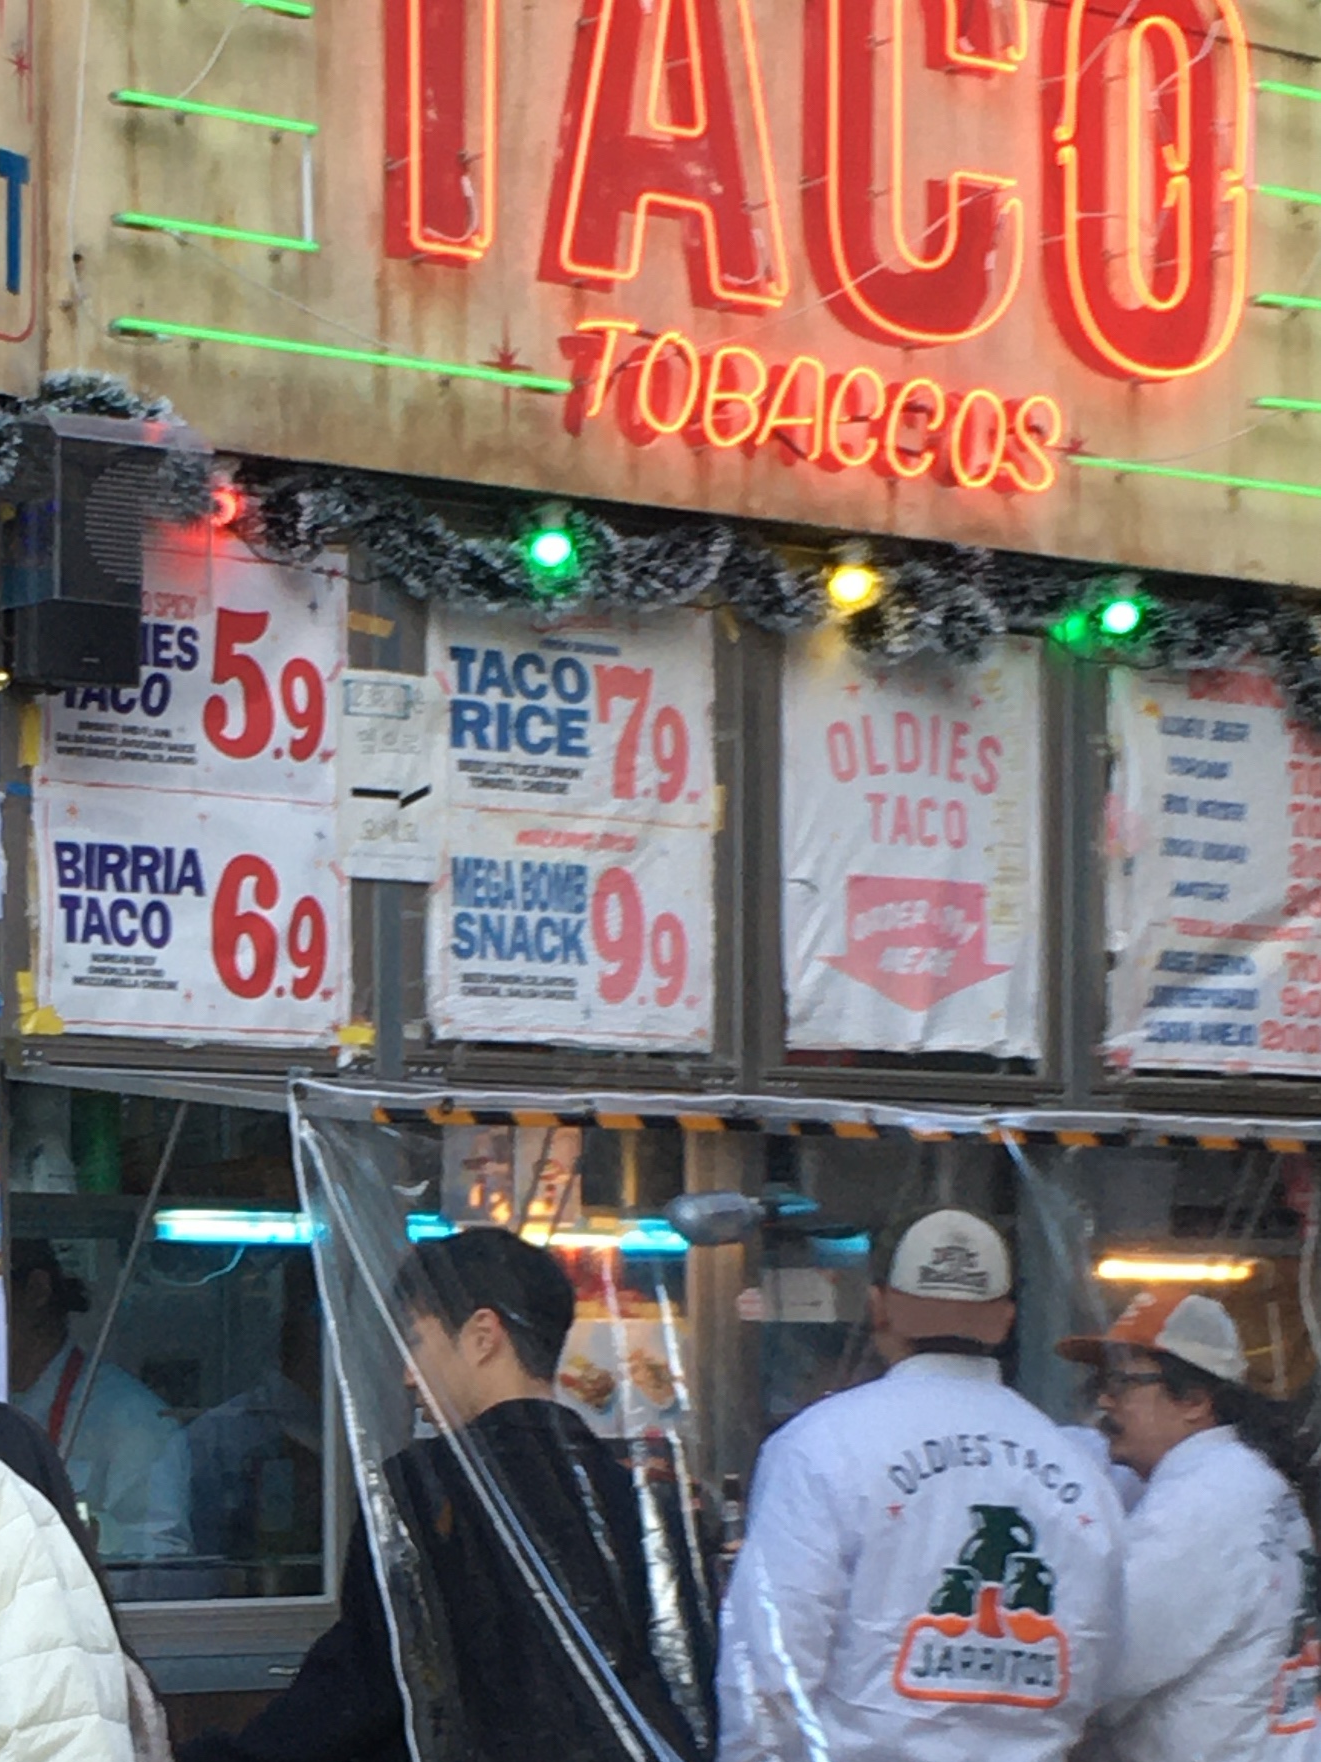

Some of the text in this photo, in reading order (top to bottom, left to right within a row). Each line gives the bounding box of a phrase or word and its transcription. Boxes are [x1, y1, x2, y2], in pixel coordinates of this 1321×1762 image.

[559, 318, 1063, 494] TOBACCOS
[139, 622, 200, 671] IES
[450, 646, 591, 704] TACO
[203, 607, 326, 762] 5.9
[450, 699, 591, 757] RICE
[593, 662, 690, 803] 7.9
[825, 711, 1004, 795] OLDIES
[864, 793, 969, 849] TACO
[54, 841, 206, 897] BIRRIA
[59, 894, 172, 949] TACO
[211, 854, 327, 1000] 6.9
[451, 912, 588, 965] SNACK
[591, 867, 689, 1007] 9.9
[887, 1434, 1082, 1504] OLDIES TACO
